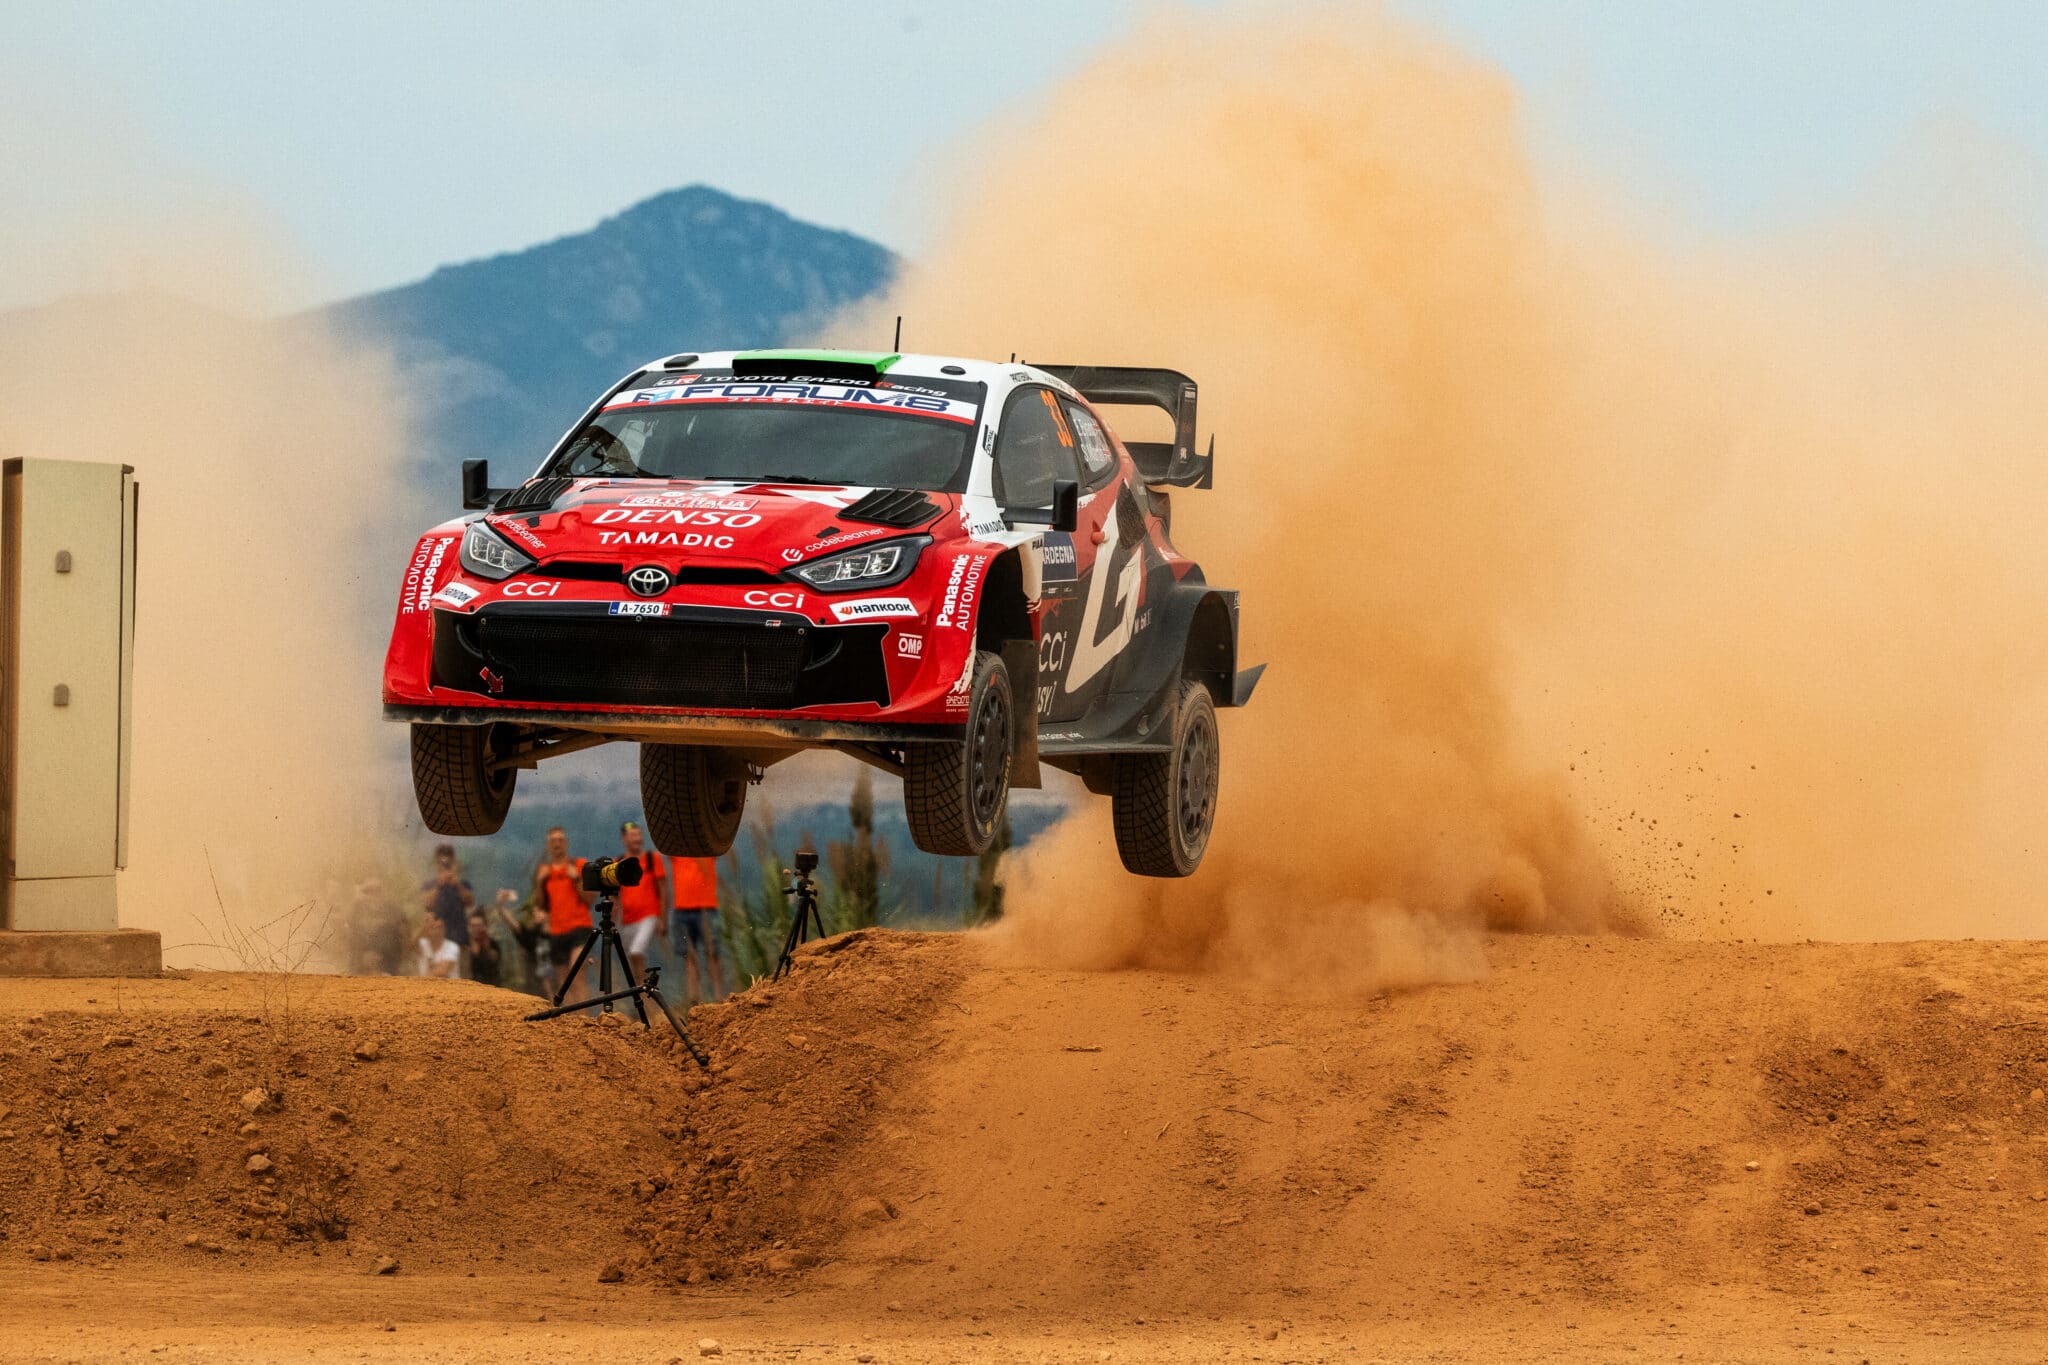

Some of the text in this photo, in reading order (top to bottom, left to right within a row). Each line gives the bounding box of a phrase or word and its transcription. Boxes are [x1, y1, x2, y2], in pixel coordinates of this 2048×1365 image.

[682, 384, 950, 412] FORUM8
[875, 381, 947, 396] Racing
[592, 509, 762, 528] DENSO
[974, 520, 1005, 535] TAMADIC
[598, 531, 735, 549] TAMADIC
[805, 527, 885, 552] codebeamer
[1042, 545, 1075, 565] RDEGNA
[402, 537, 435, 615] AUTOMOTIVE
[418, 537, 455, 611] Panasonic
[936, 554, 970, 627] Panasonic
[956, 554, 988, 632] AUTOMOTIVE
[621, 604, 660, 614] A-7650
[898, 637, 922, 655] OMP
